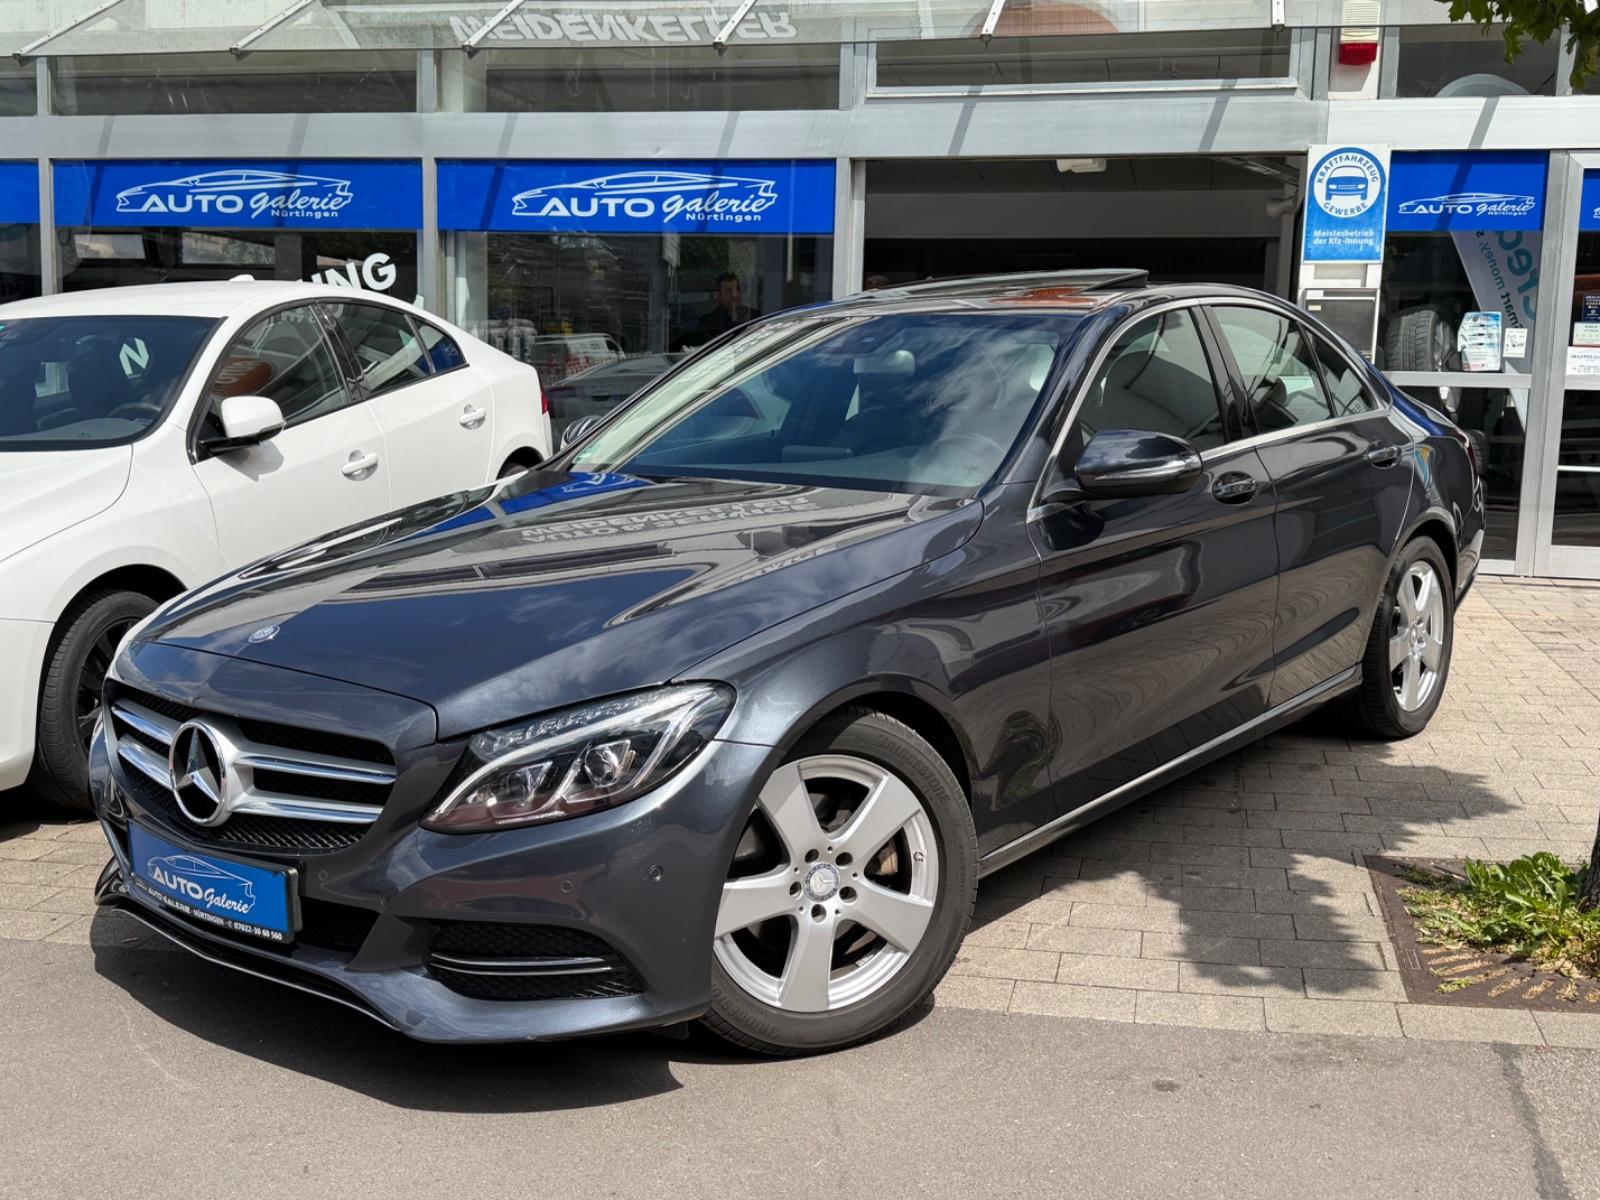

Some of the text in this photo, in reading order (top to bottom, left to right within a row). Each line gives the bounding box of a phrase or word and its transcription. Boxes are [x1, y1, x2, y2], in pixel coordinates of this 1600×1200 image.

[1316, 154, 1379, 184] KRAFTFAHRZEUG
[146, 189, 343, 219] AUTO galerie
[546, 191, 766, 223] AUTO galerie
[1323, 202, 1368, 216] GEWERBE
[1413, 201, 1529, 216] AUTO galerie
[271, 209, 338, 220] Nürtingen
[686, 213, 762, 223] Nürtingen
[1313, 228, 1375, 238] Meisterbetrieb
[1313, 237, 1375, 247] der Kfz-Innung
[152, 866, 251, 914] AUTO Galerie
